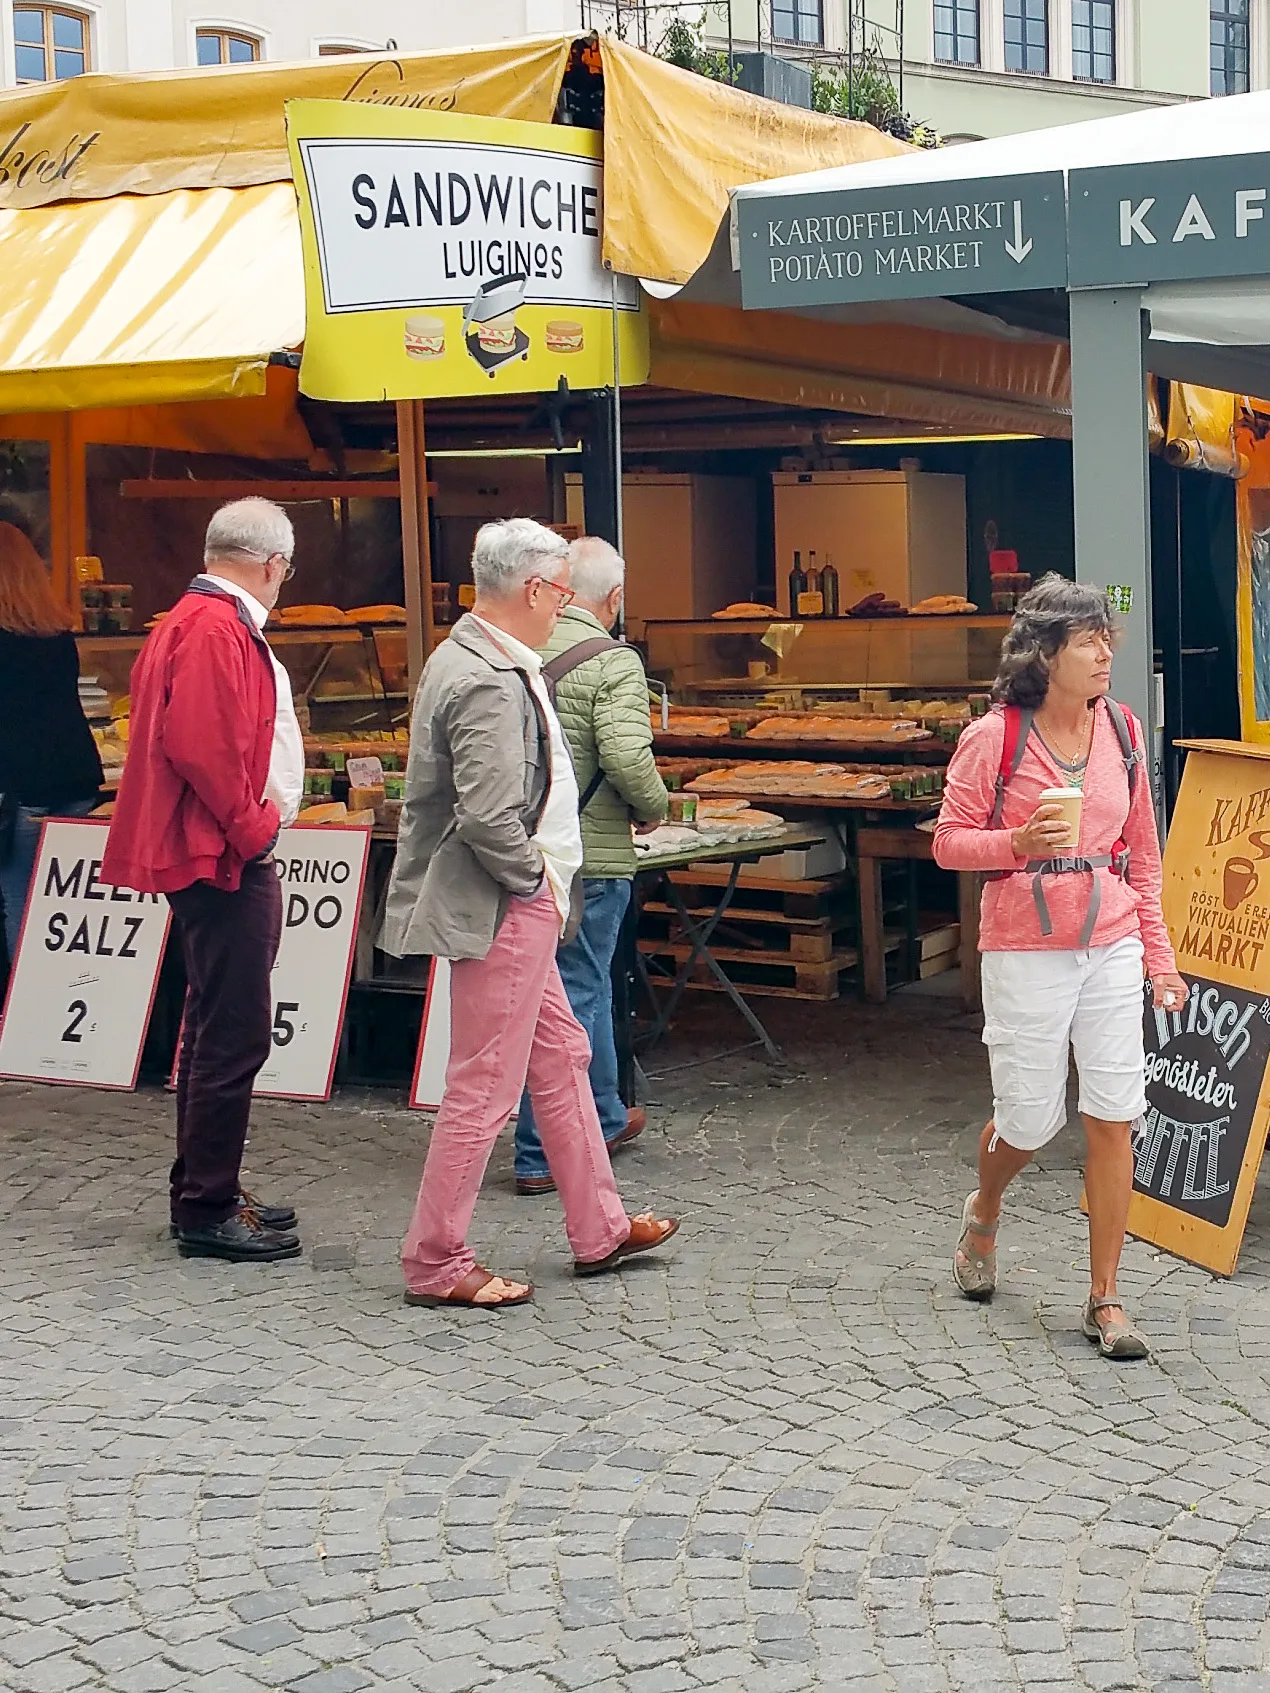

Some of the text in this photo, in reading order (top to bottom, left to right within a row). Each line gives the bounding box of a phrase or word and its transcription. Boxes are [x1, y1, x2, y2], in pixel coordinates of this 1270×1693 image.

[352, 172, 599, 237] SANDWICHE
[768, 201, 1005, 247] KARTOFFELMARKT
[769, 241, 983, 283] POTATO MARKET
[44, 857, 159, 904] ME
[1192, 890, 1219, 907] RÖST
[285, 894, 342, 929] DO
[1189, 905, 1270, 940] VIKTUALIEN
[45, 912, 144, 957] SALZ
[1179, 925, 1264, 971] MARKT
[61, 1000, 87, 1042] 2
[271, 1002, 299, 1047] 5
[1131, 1101, 1230, 1200] AFFEE
